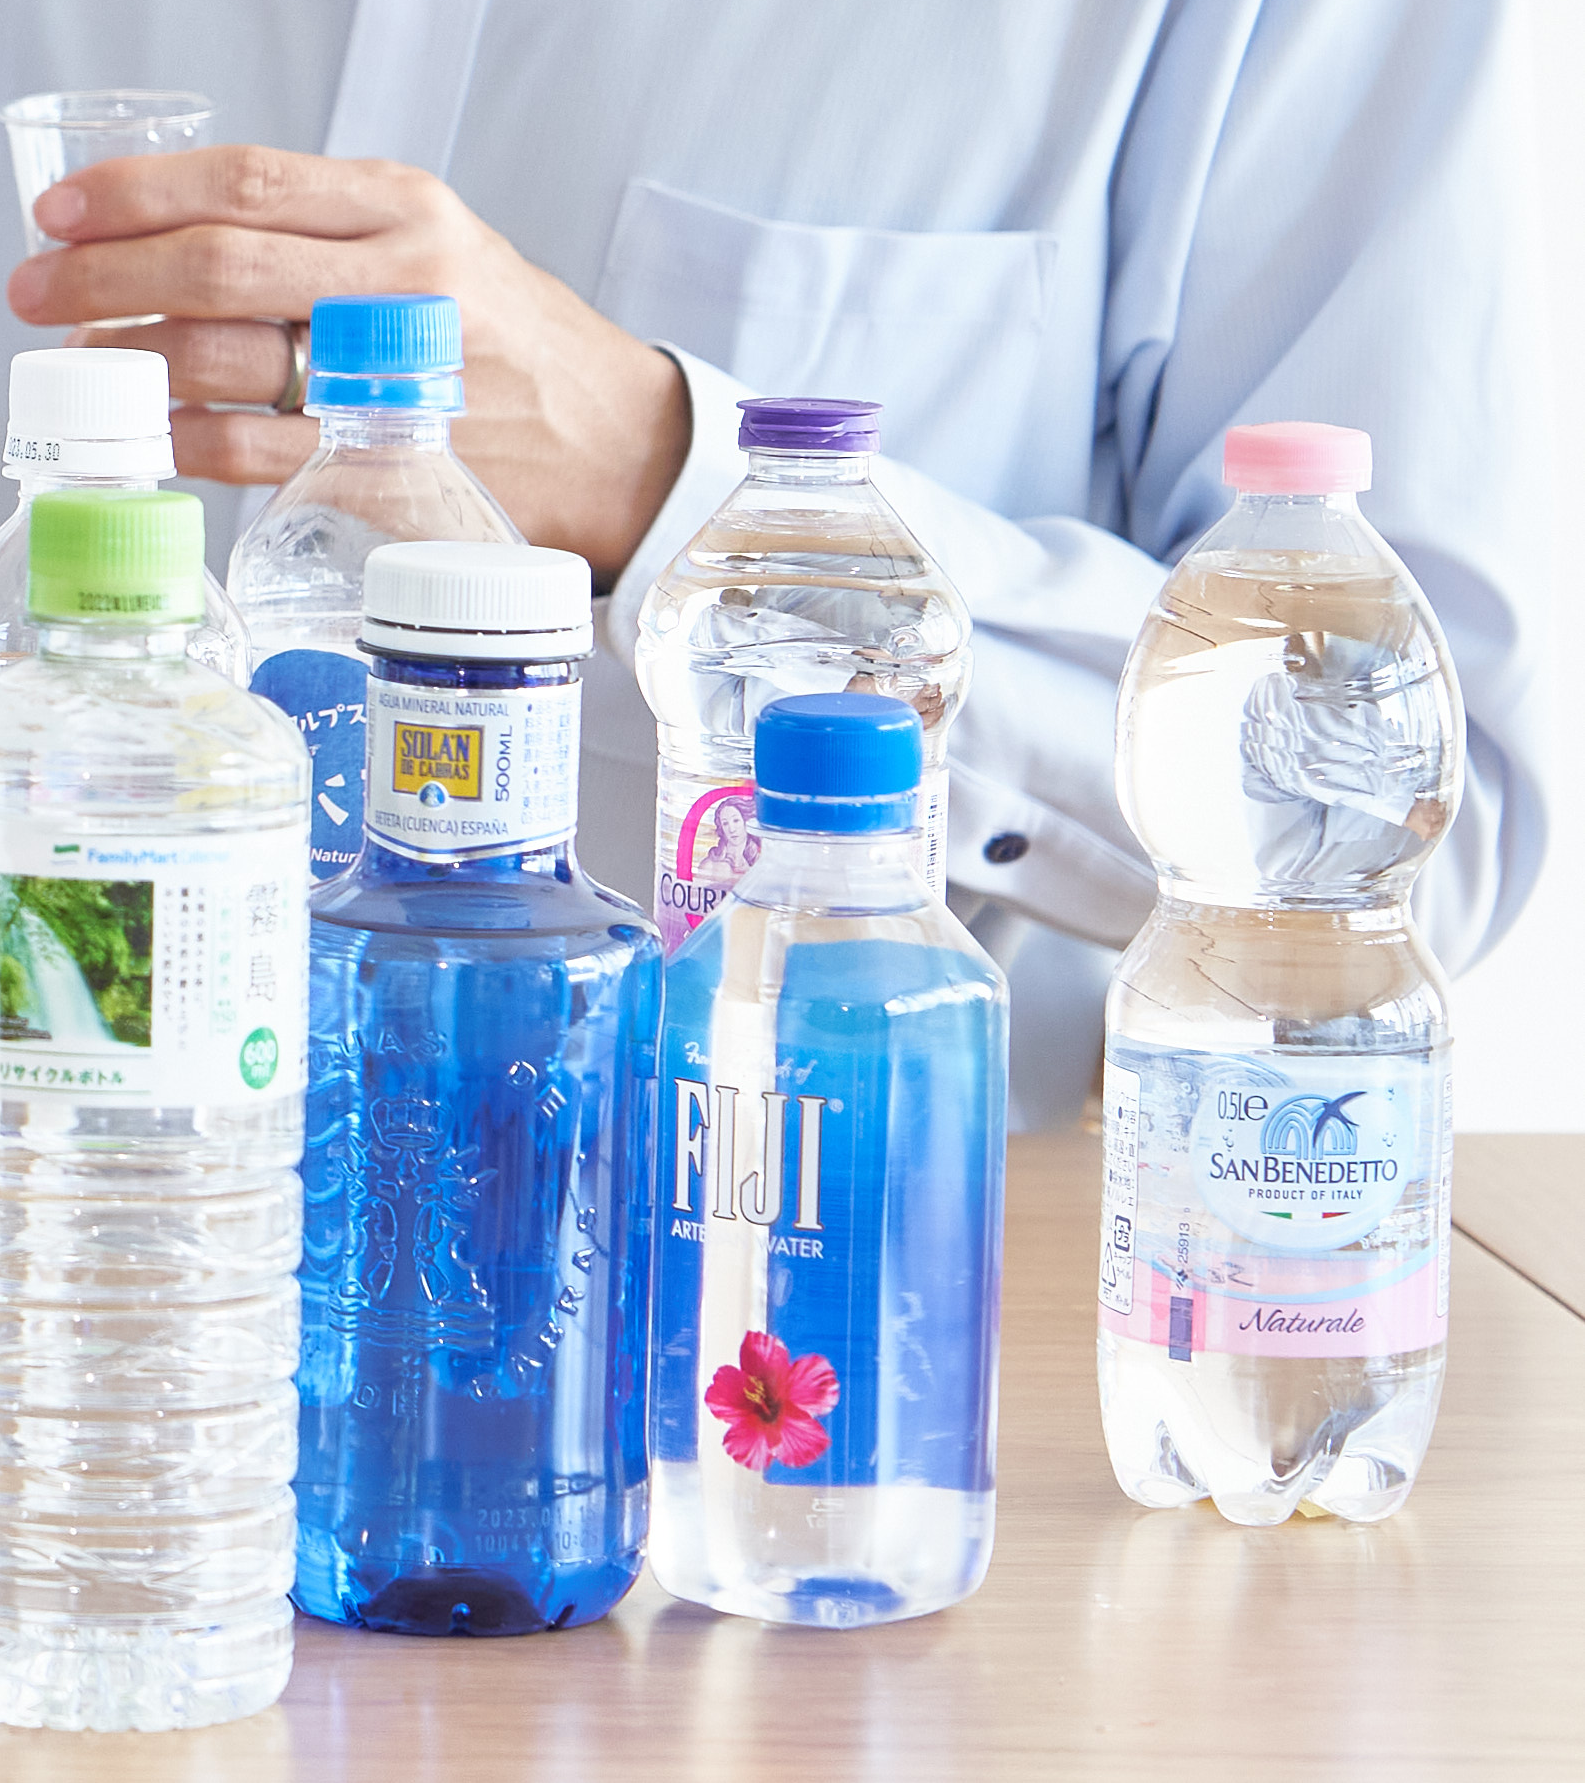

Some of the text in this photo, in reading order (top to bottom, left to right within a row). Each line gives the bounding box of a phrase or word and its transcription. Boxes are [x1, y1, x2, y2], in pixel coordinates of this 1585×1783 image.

[402, 697, 451, 715] MINERAL
[455, 702, 509, 717] NATURAL
[400, 758, 470, 781] DE CABRAS
[495, 725, 513, 802] 500ML
[402, 815, 459, 837] (CUENCA)
[461, 818, 509, 836] ESPAÑA
[660, 872, 727, 913] COUR
[243, 1039, 278, 1066] 600
[672, 1077, 829, 1232] FIJI
[1210, 1151, 1399, 1186] SAN BENEDETTO
[1248, 1187, 1364, 1201] PRODUCT OF ITALY
[1239, 1307, 1366, 1336] Naturale
